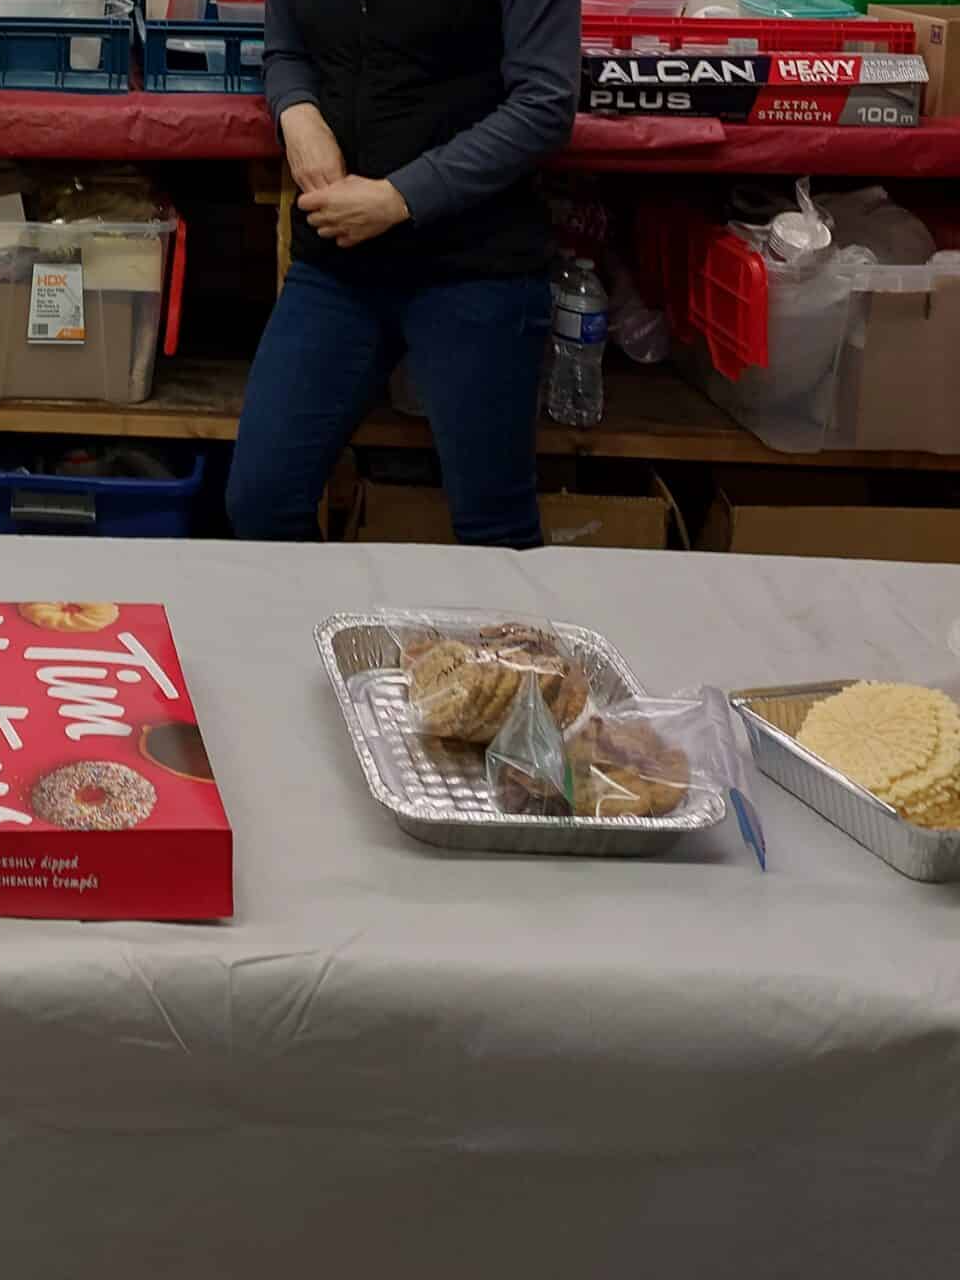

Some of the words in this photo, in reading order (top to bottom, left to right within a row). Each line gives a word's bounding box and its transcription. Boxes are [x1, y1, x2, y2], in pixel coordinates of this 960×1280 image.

[598, 59, 756, 83] ALCAN
[778, 59, 856, 77] HEAVY
[589, 90, 692, 109] PLUS
[773, 100, 818, 111] EXTRA
[758, 111, 833, 122] STRENGTH
[35, 273, 67, 287] HDX
[23, 632, 179, 740] Tim
[40, 852, 80, 874] dipped
[52, 873, 100, 894] trempés
